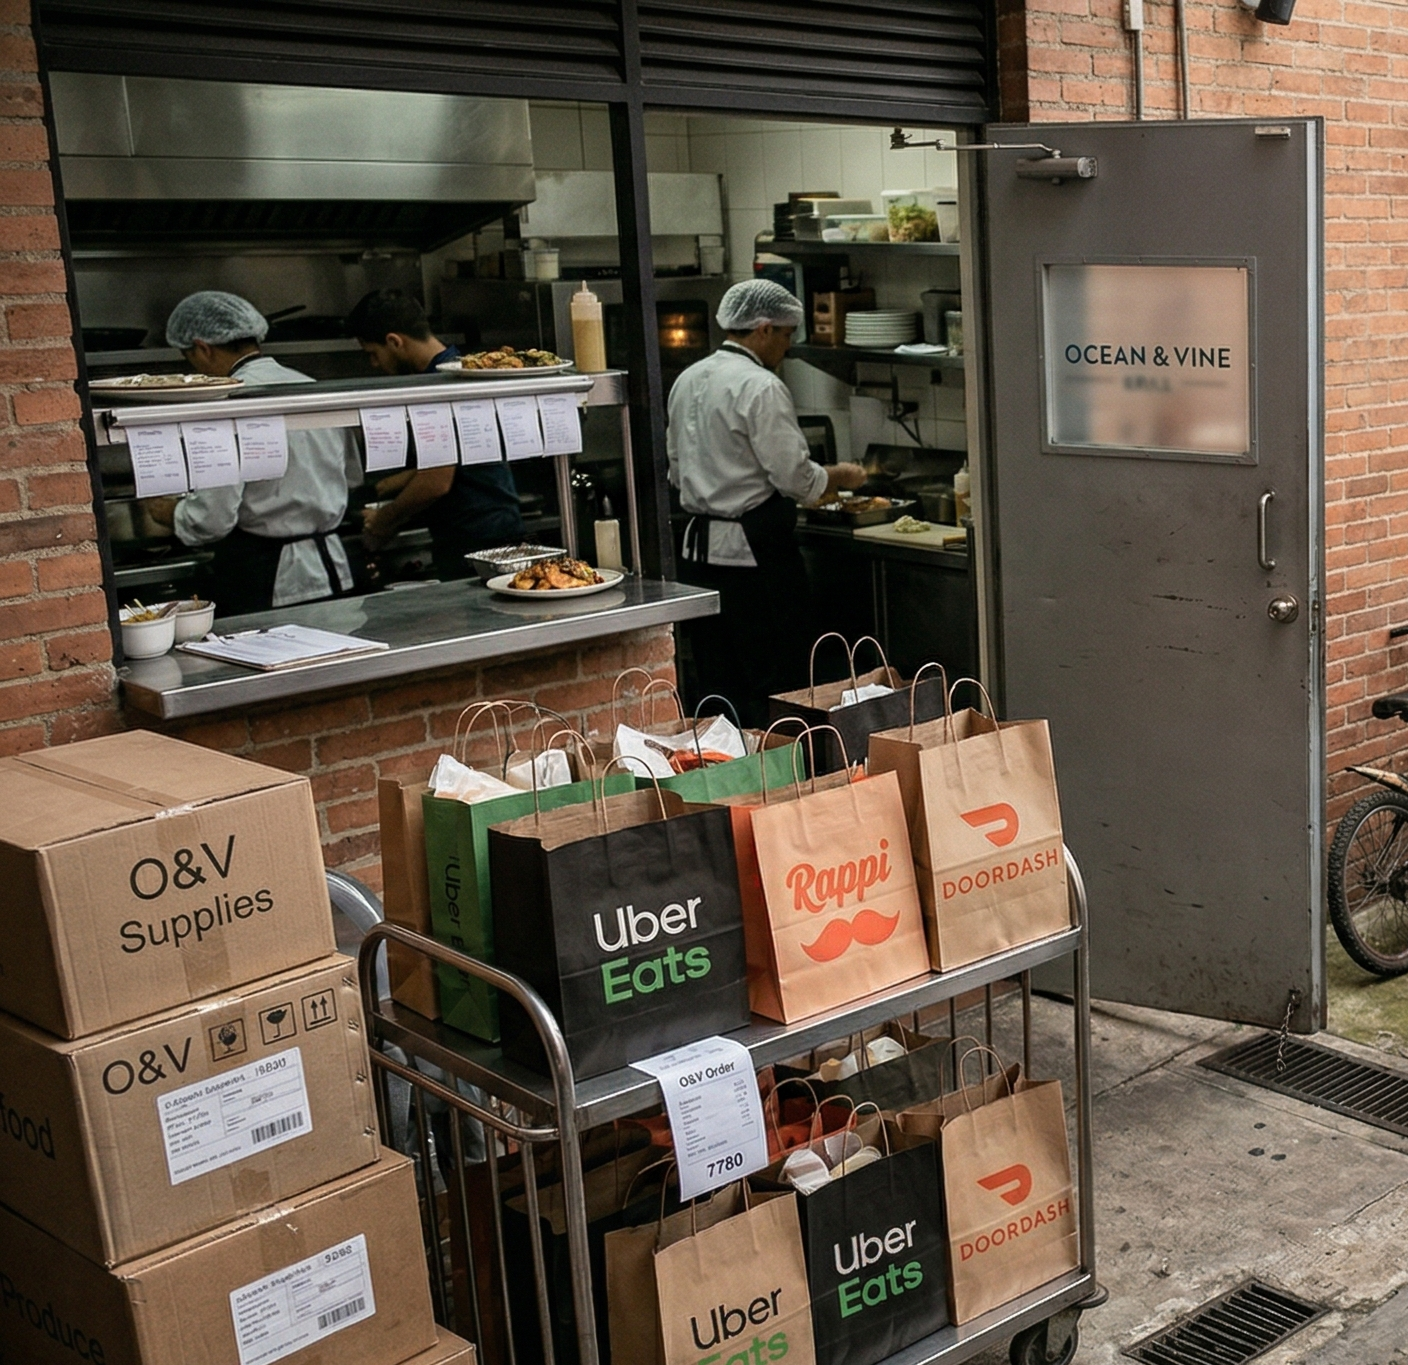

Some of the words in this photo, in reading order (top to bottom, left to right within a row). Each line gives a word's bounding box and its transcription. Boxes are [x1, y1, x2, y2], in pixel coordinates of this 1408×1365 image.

[1065, 344, 1146, 365] OCEAN
[1153, 346, 1170, 367] &
[1174, 347, 1231, 368] VINE
[130, 835, 235, 900] O&V
[786, 838, 892, 913] Rappi
[942, 848, 1059, 900] DOORDASH
[120, 889, 274, 953] Supplies
[593, 896, 702, 952] Uber
[601, 946, 712, 1004] Eats
[102, 1037, 192, 1096] O&V
[679, 1071, 703, 1087] O&V
[705, 1061, 735, 1079] Order
[707, 1152, 743, 1178] 7780
[834, 1220, 917, 1275] Uber
[960, 1198, 1070, 1261] DOORDASH
[838, 1260, 923, 1318] Eats
[690, 1287, 782, 1350] Uber
